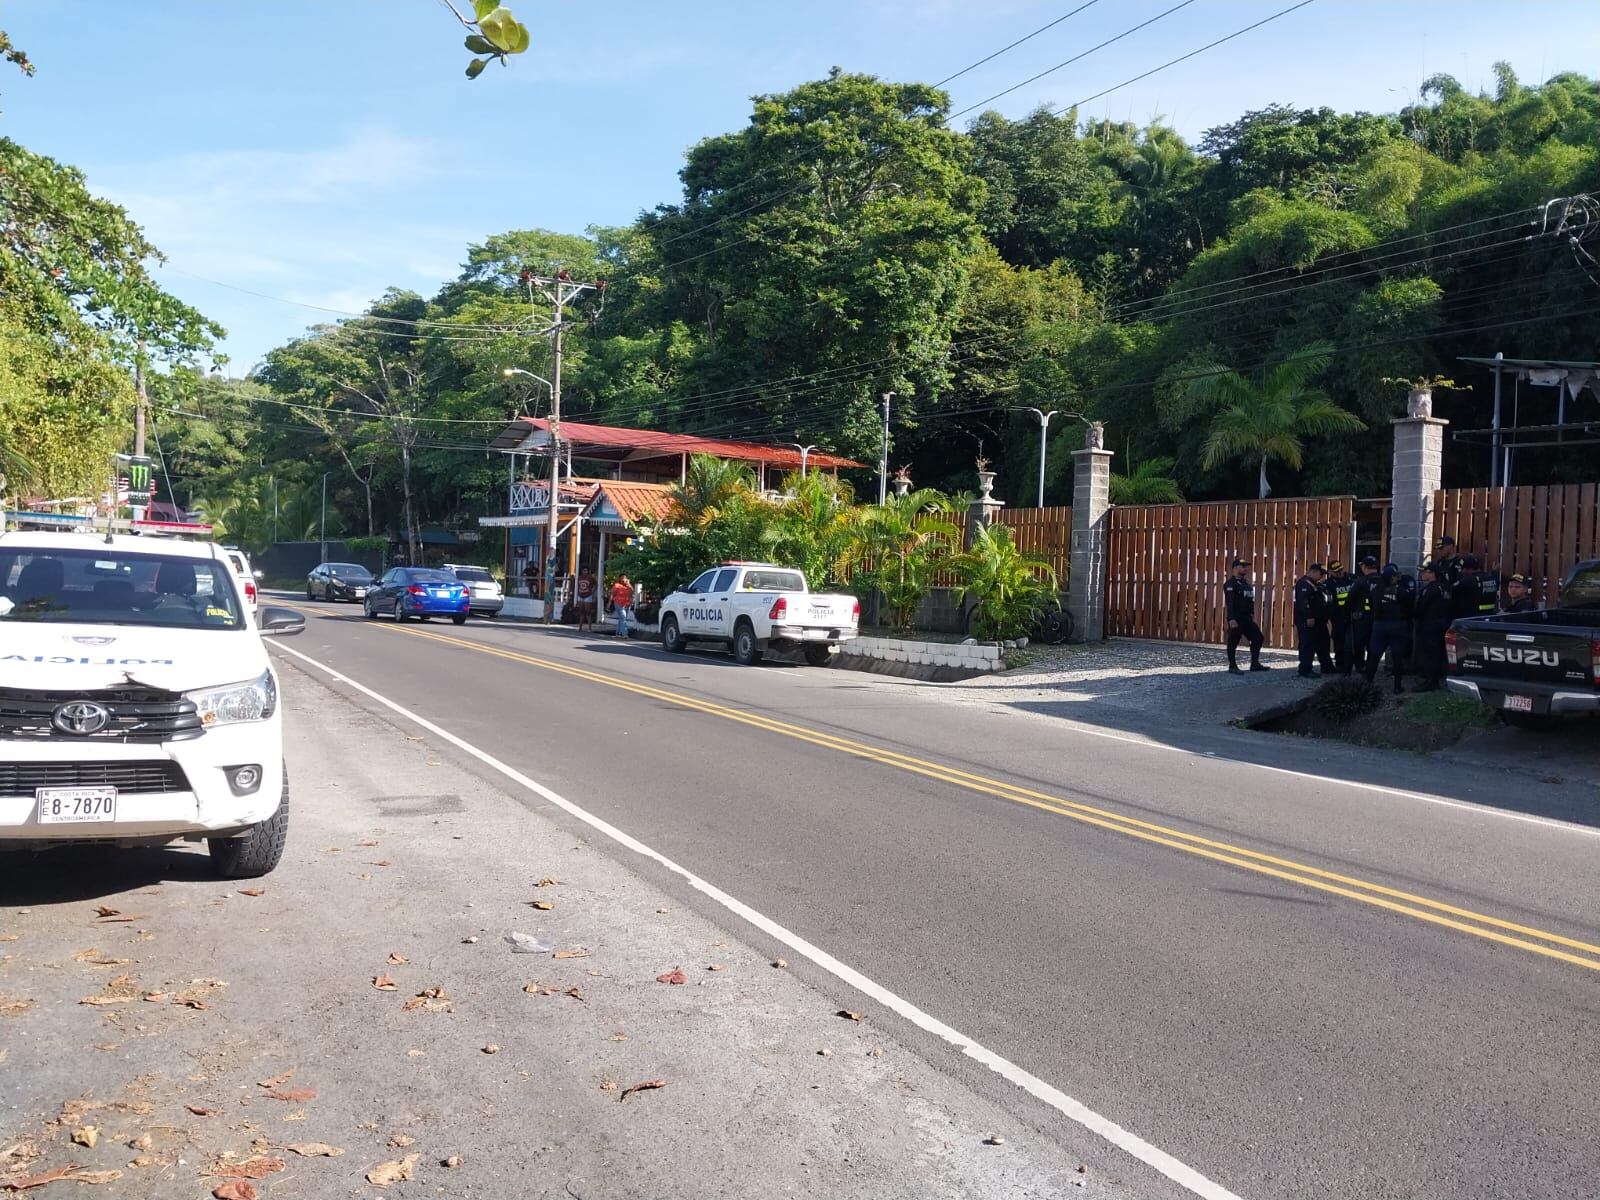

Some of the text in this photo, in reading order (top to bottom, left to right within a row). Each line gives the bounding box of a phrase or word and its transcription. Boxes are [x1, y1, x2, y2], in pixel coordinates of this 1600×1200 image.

[689, 608, 723, 621] POLICIA
[1483, 646, 1559, 667] ISUZU
[52, 797, 112, 815] 8-7870
